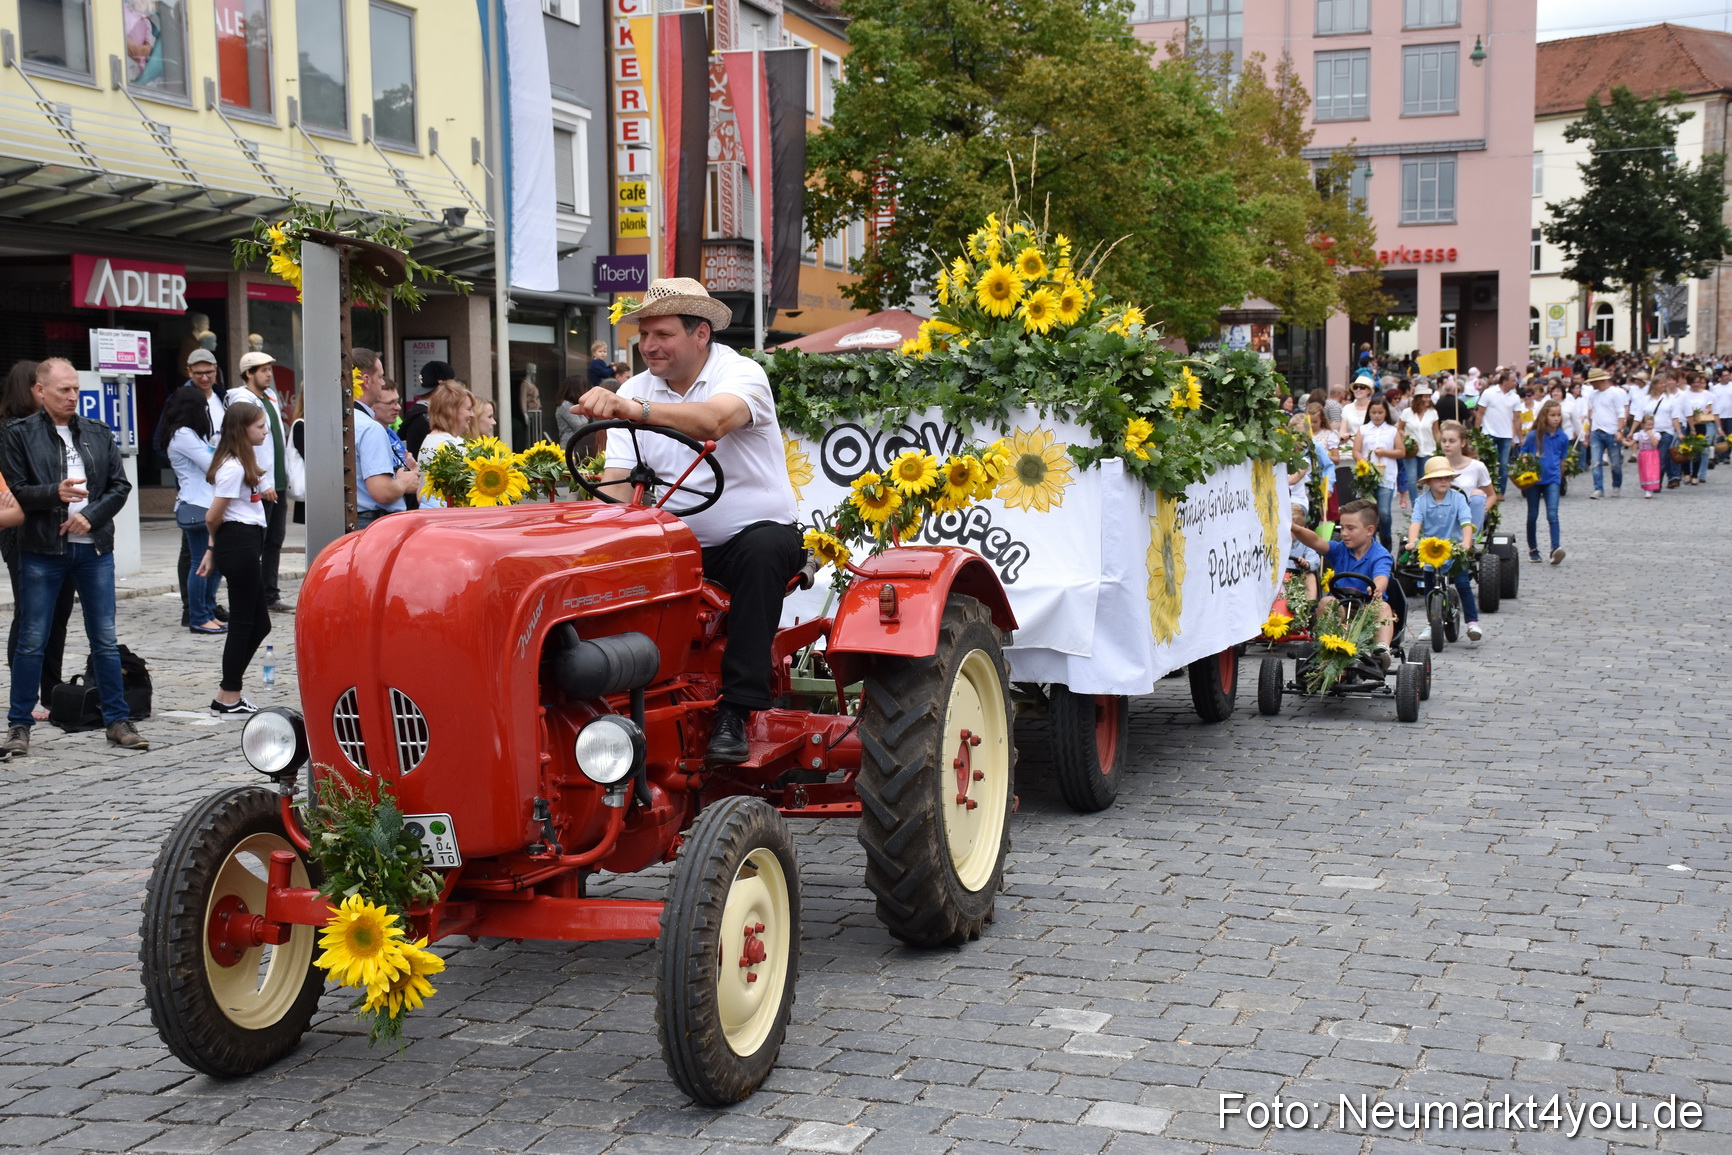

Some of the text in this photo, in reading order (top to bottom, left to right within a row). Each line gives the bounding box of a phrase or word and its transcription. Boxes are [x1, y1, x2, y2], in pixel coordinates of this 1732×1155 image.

[620, 184, 646, 201] café
[620, 217, 647, 234] plank
[1366, 245, 1458, 264] arkasse
[599, 263, 645, 284] liberty
[91, 259, 188, 310] ADLER
[413, 342, 436, 350] ADLER
[82, 395, 97, 417] P
[513, 594, 546, 659] Junior
[440, 854, 455, 864] 10
